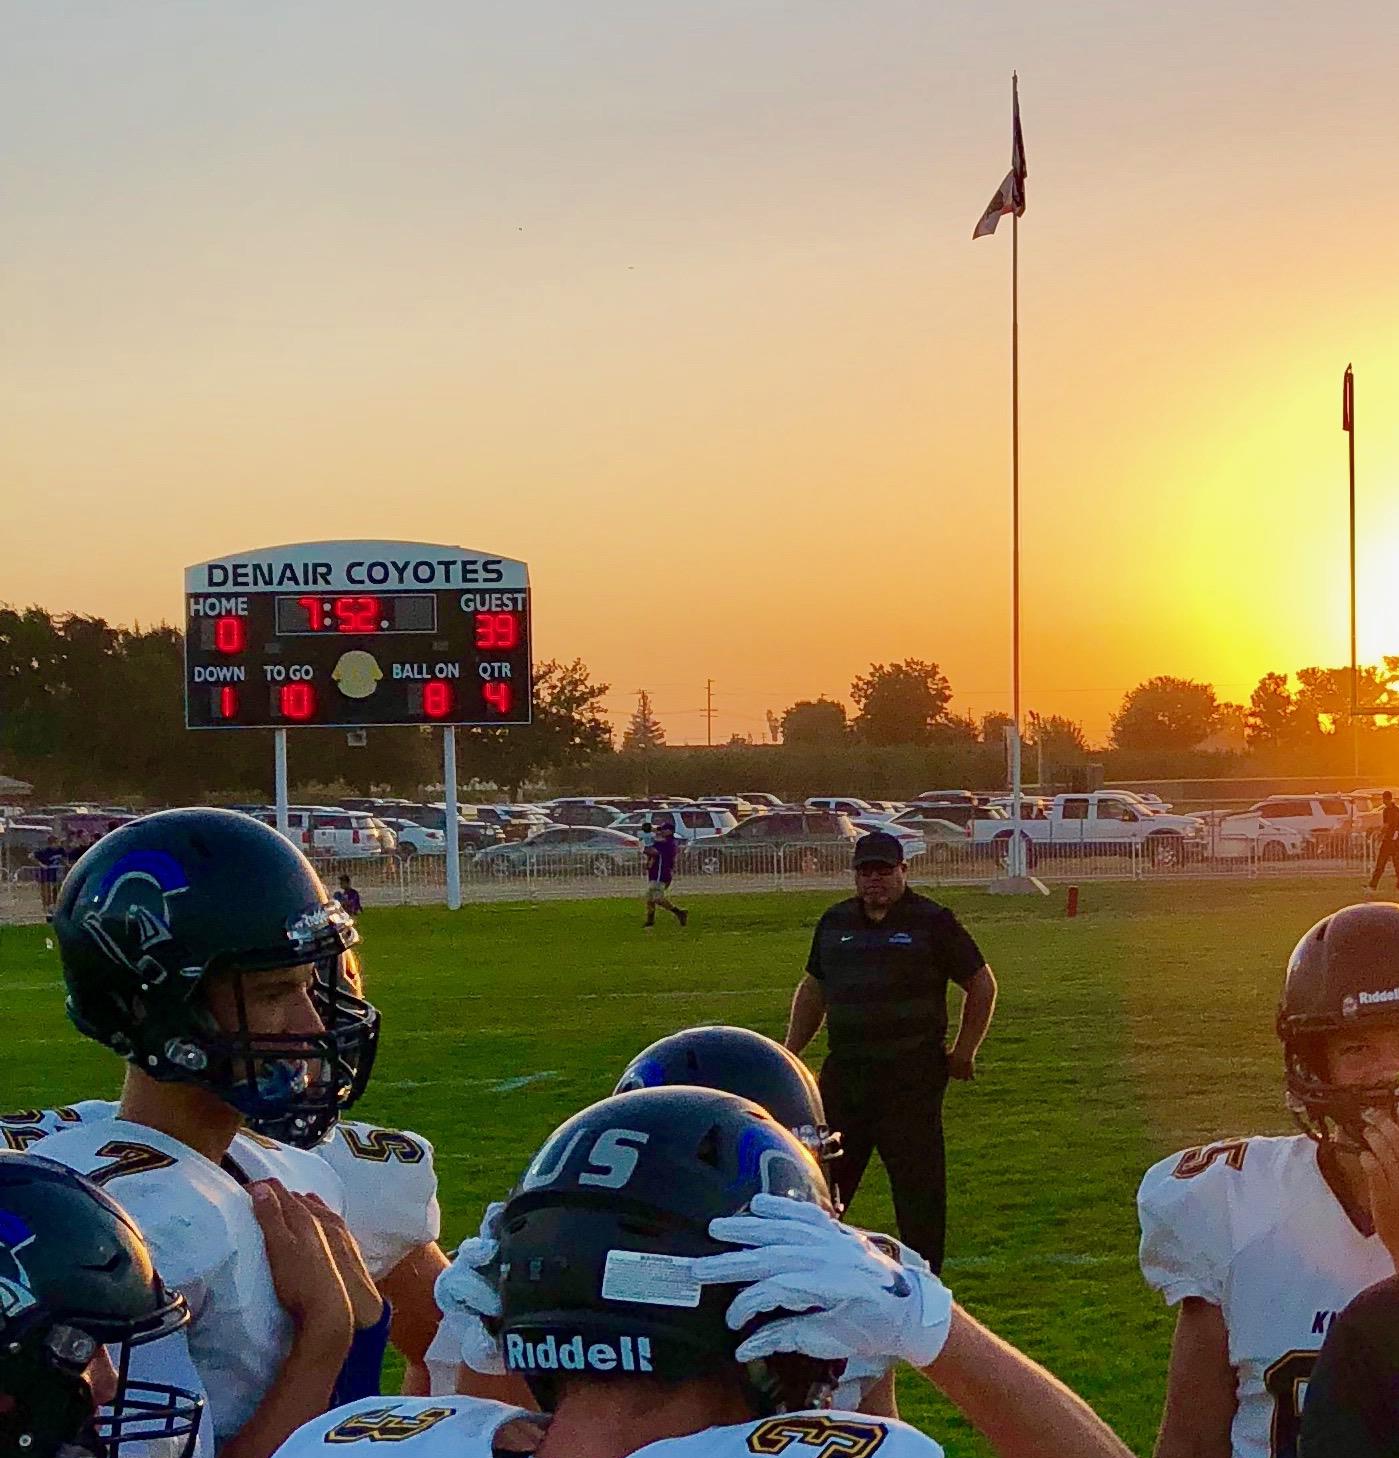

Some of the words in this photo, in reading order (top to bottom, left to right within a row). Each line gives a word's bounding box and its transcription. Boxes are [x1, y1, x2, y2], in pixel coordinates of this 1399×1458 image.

[207, 561, 332, 587] DENAIR
[345, 560, 504, 585] COYOTES
[190, 597, 248, 616] HOME
[460, 594, 526, 612] GUEST
[217, 617, 244, 651] 0
[475, 614, 518, 649] 39
[194, 666, 245, 682] DOWN
[264, 665, 286, 681] TO
[289, 664, 313, 680] GO
[393, 664, 431, 679] BALL
[434, 663, 460, 679] ON
[478, 662, 512, 679] QTR
[221, 685, 236, 718] 1
[484, 683, 510, 714] 4
[522, 1127, 650, 1192] US
[504, 1333, 654, 1373] Riddell
